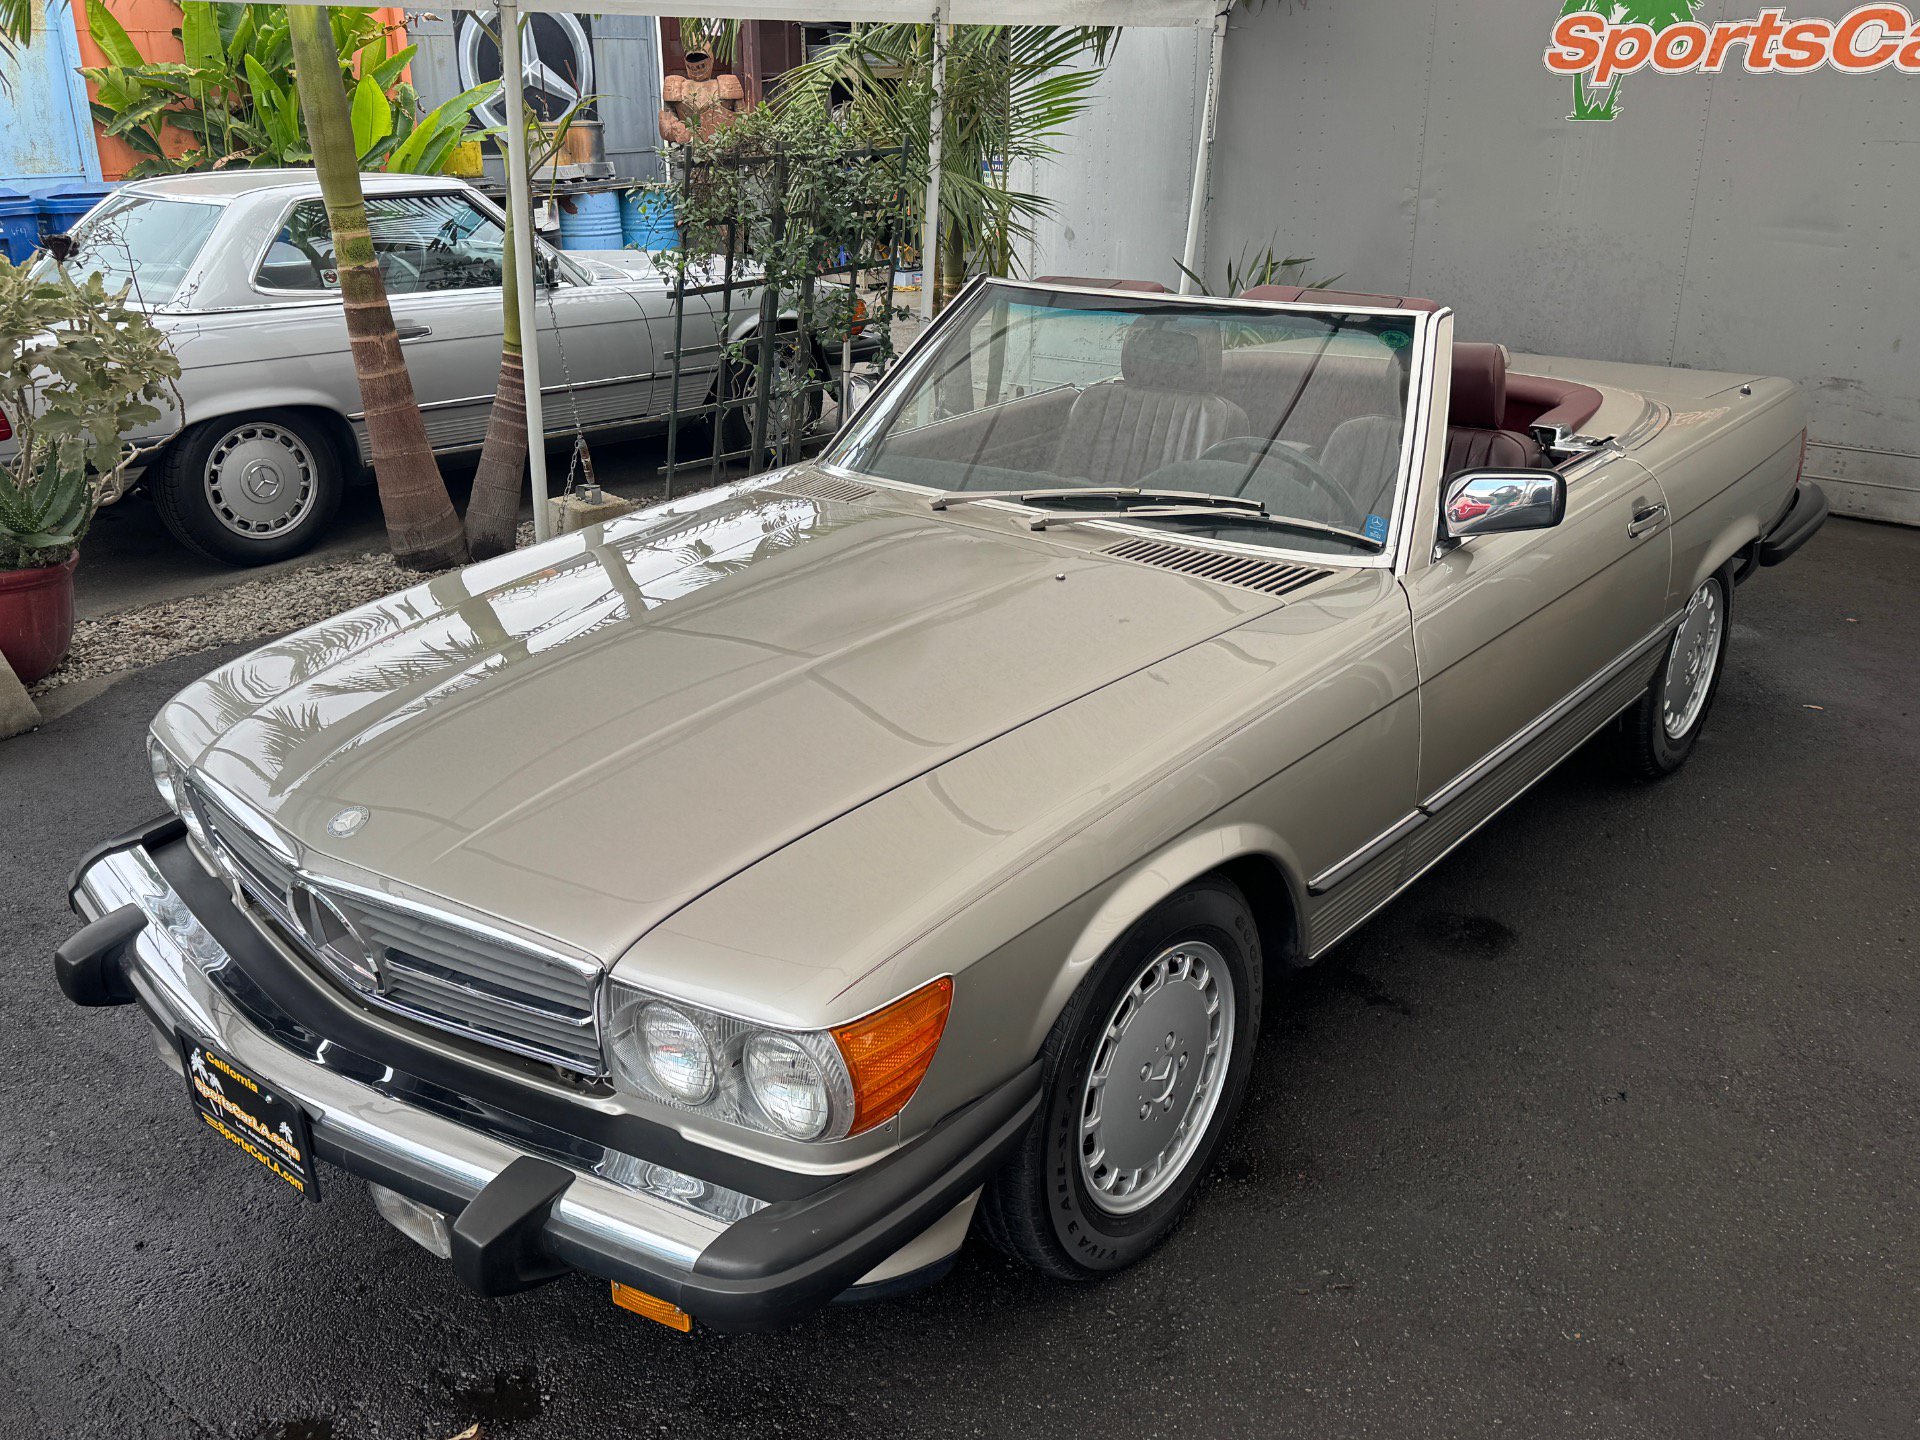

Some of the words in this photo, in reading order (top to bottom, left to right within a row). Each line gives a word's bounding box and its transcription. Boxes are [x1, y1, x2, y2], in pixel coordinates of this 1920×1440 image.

[206, 1051, 258, 1093] California
[194, 1076, 300, 1161] SportsCarLA.com
[218, 1122, 303, 1192] SportsCarLA.com
